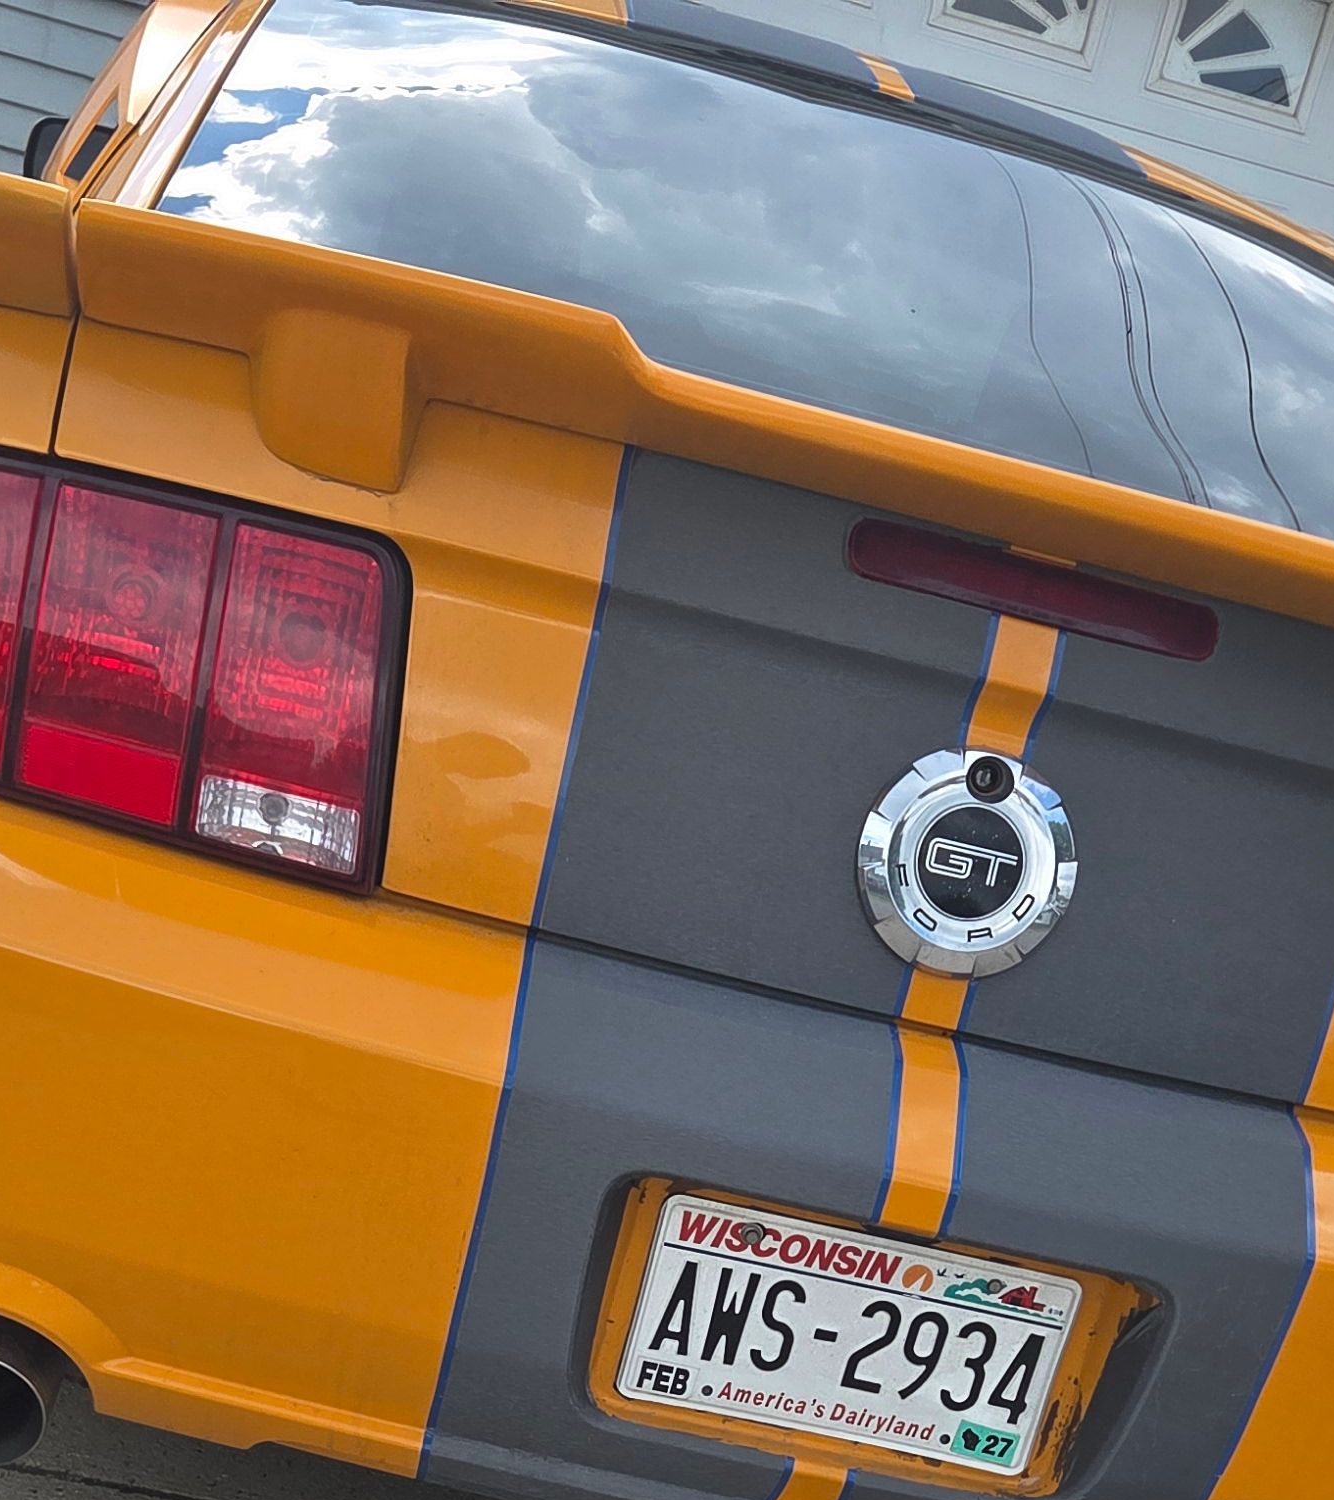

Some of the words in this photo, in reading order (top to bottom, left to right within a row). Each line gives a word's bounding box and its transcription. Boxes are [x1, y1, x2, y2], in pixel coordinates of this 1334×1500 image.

[925, 837, 1019, 888] GT
[678, 1210, 903, 1285] WISCONSIN
[648, 1260, 1047, 1425] AWS-2934
[636, 1360, 690, 1396] FEB
[717, 1381, 826, 1419] America's
[829, 1403, 936, 1441] Dairyland
[981, 1434, 1015, 1458] 27
